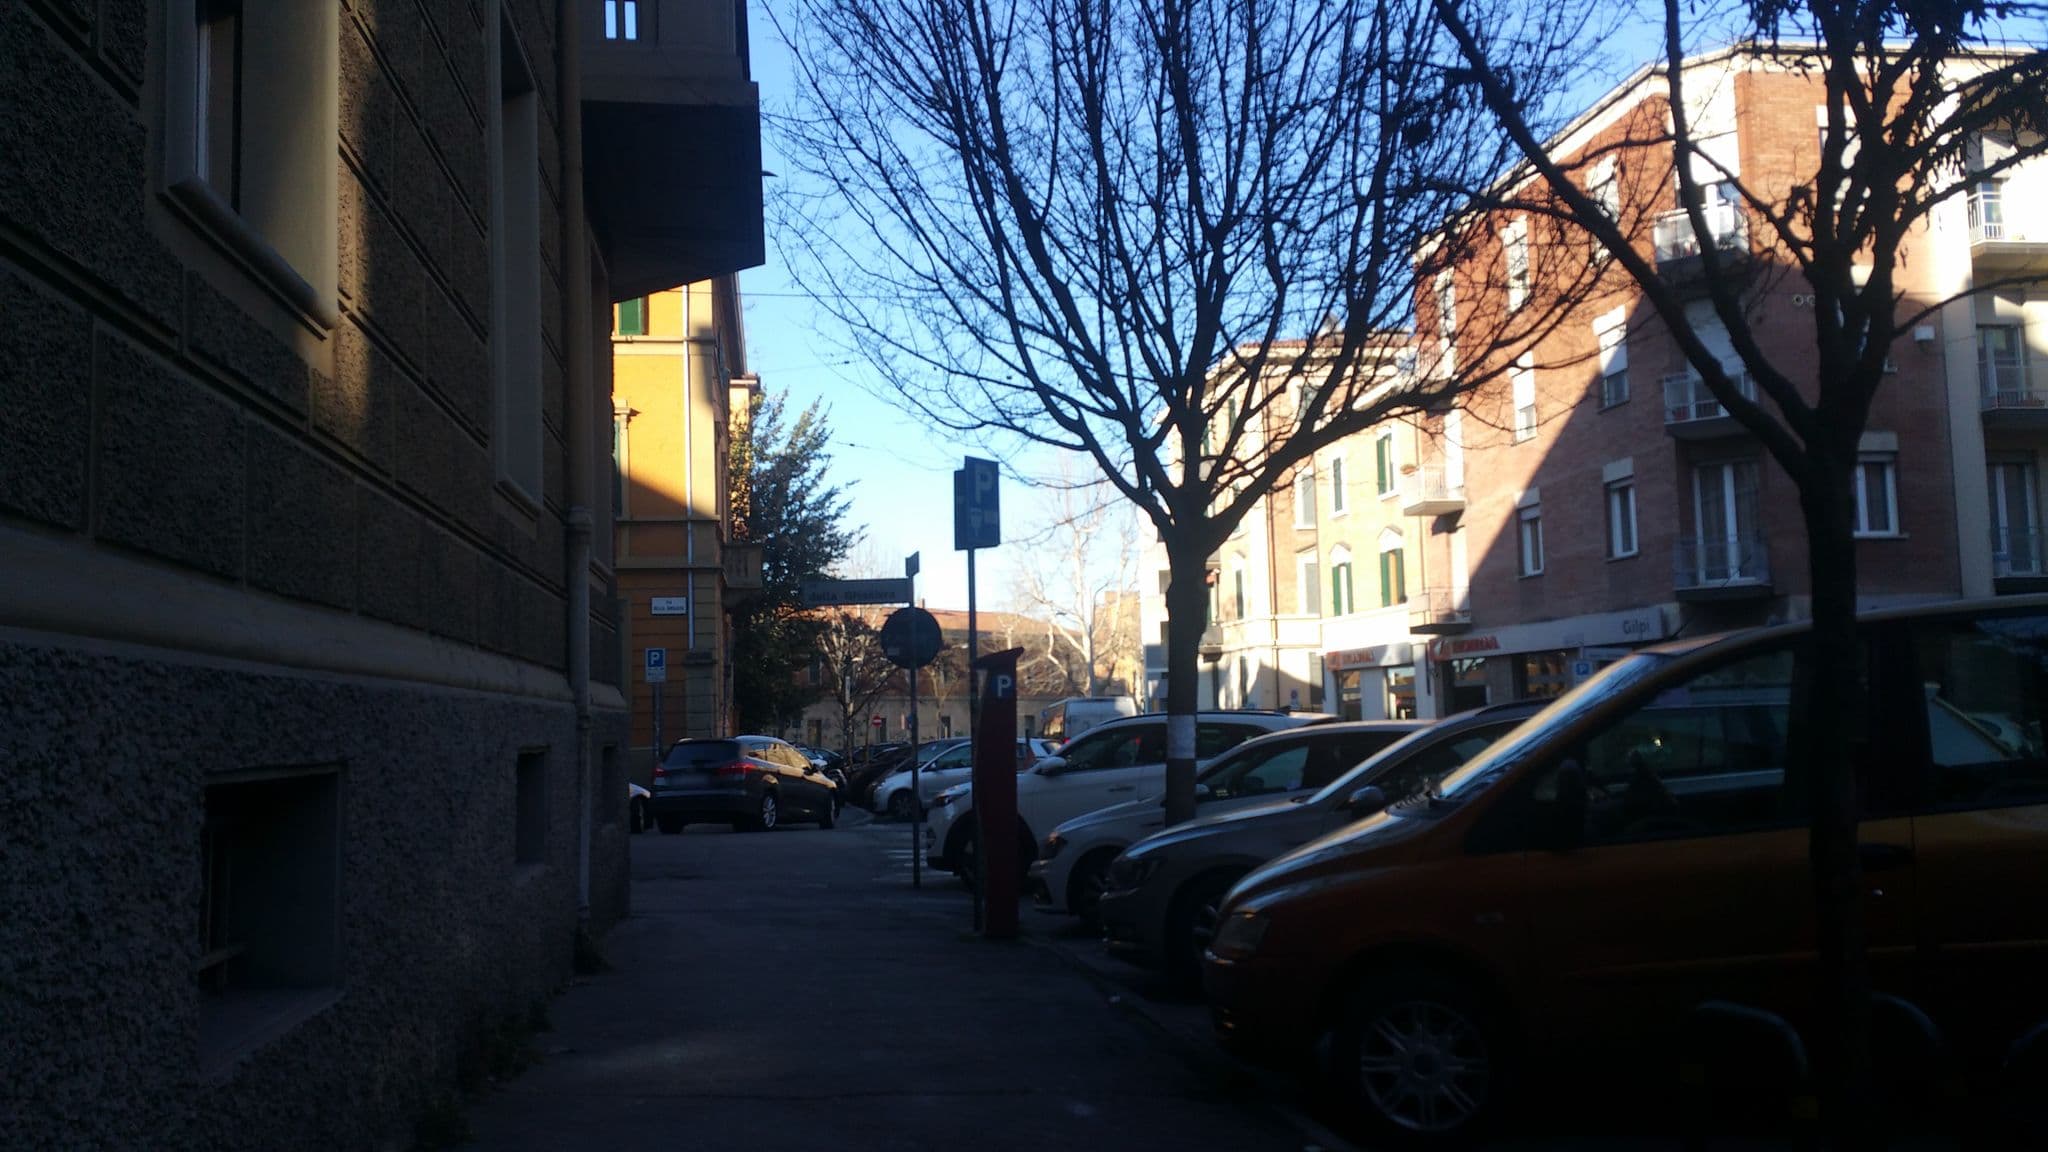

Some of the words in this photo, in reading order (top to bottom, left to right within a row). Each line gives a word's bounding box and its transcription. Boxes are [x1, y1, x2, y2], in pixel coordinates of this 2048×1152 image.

[974, 464, 993, 504] P
[650, 651, 660, 665] P
[997, 674, 1012, 697] P
